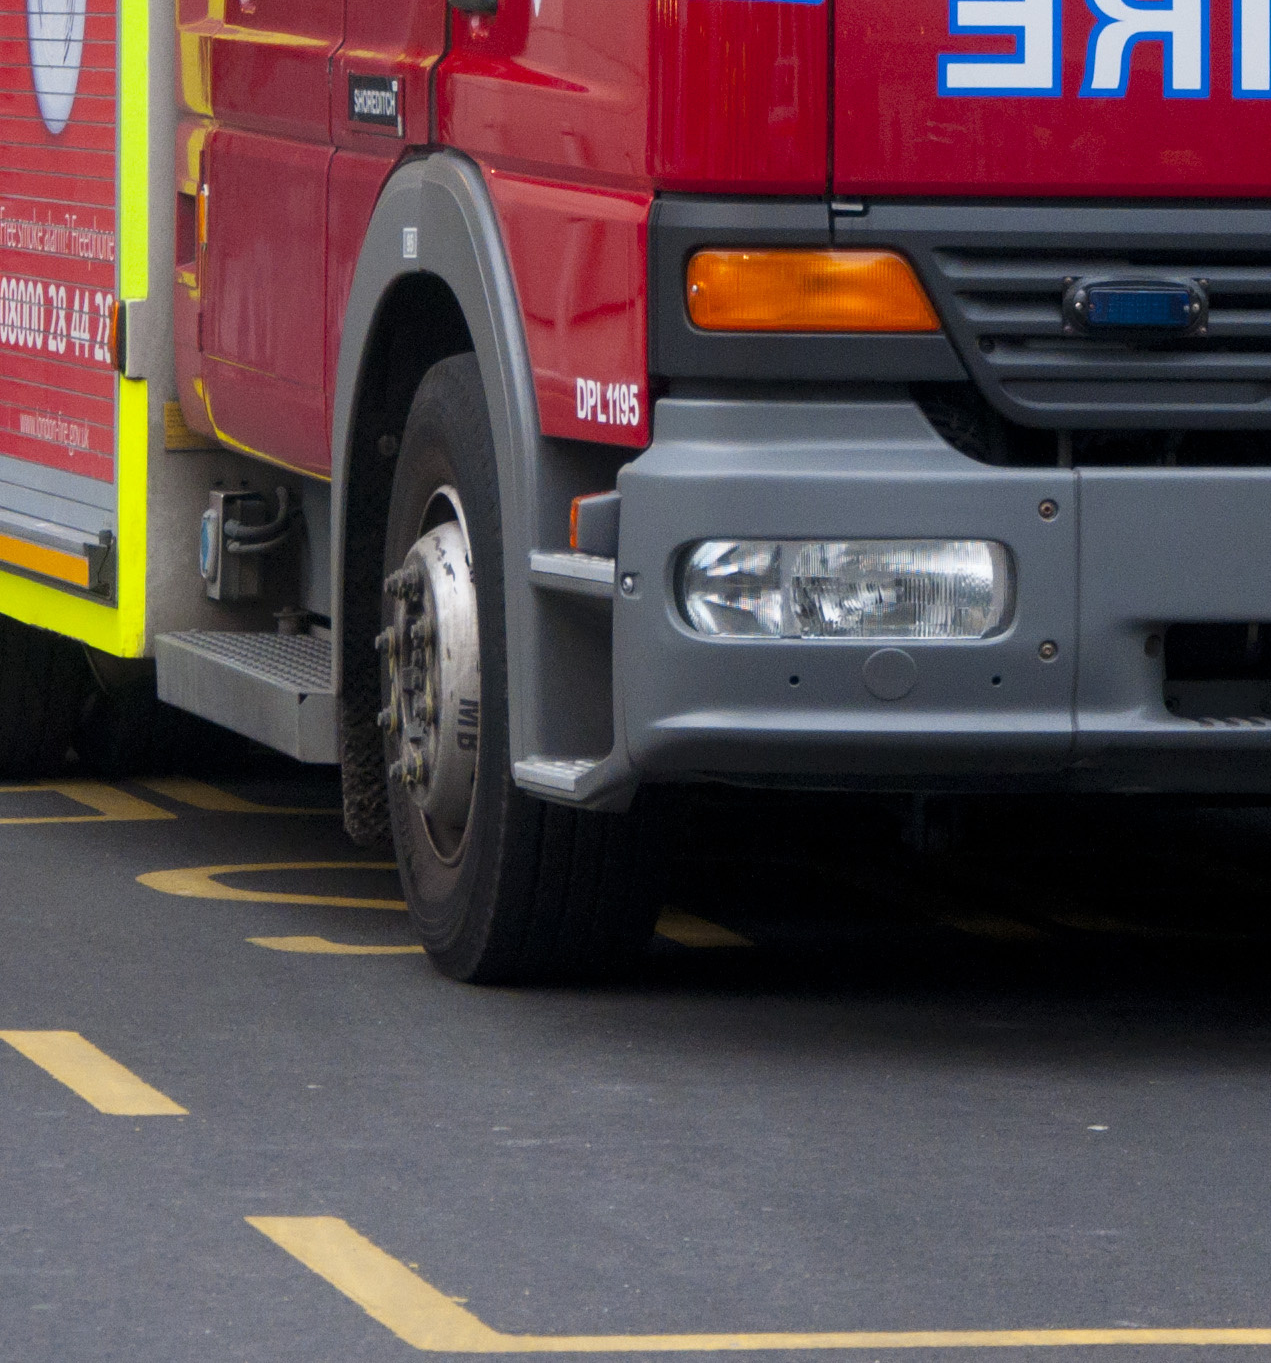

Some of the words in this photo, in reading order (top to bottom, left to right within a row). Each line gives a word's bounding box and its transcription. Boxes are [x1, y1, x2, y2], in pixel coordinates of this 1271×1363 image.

[354, 88, 397, 115] SHOREDITCH
[0, 206, 18, 248] Free
[18, 208, 43, 250] smoke
[44, 210, 70, 252] alarm?
[71, 215, 115, 271] Freephone
[0, 276, 44, 350] 08000
[47, 284, 67, 354] 28
[70, 289, 90, 358] 44
[576, 378, 639, 426] DPL1195
